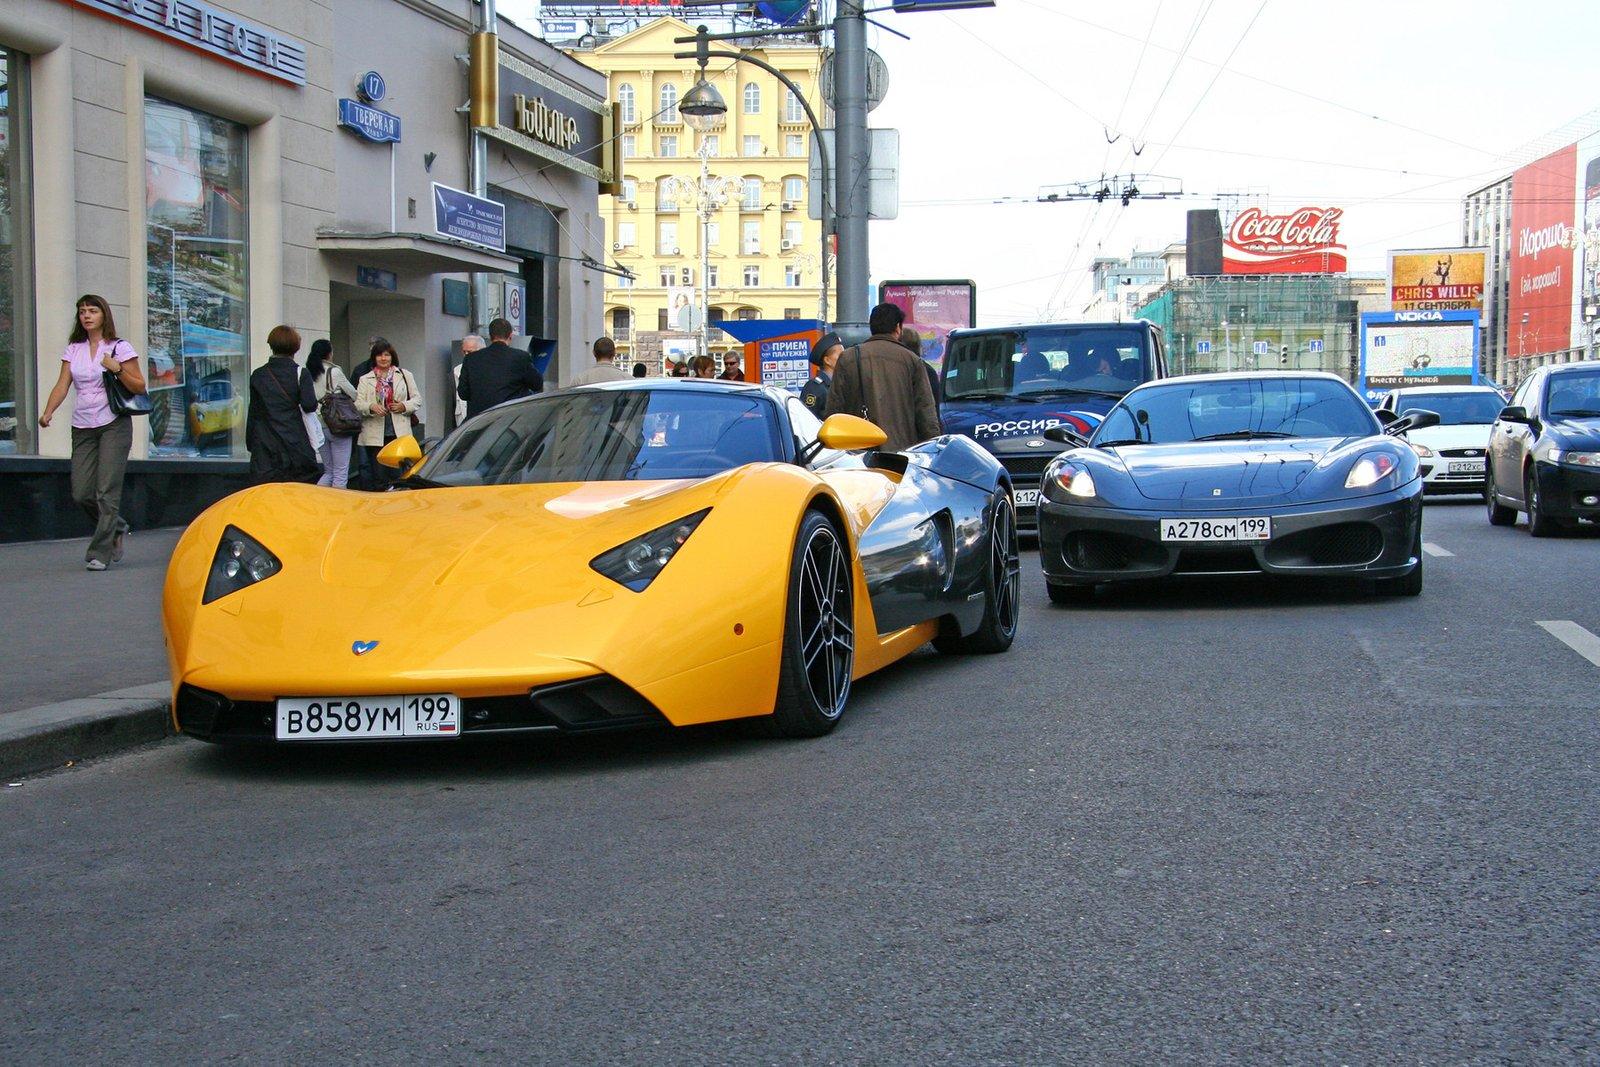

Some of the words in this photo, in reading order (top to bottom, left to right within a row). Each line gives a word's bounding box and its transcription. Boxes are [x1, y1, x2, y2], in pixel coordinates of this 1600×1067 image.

[369, 76, 379, 95] 17
[354, 106, 394, 135] ТВЕРСКАЯ
[1232, 209, 1342, 245] Coca-Cola
[1396, 287, 1433, 300] CHRIS
[1437, 286, 1480, 299] WILLIS
[1404, 302, 1415, 311] 11
[1417, 301, 1471, 311] СЕНТЯБРЯ
[1394, 311, 1443, 321] NOKIA
[772, 341, 808, 351] ПРИЕМ
[772, 349, 808, 358] ПЛАТЕЖЕЙ
[974, 419, 1060, 435] РОССИЯ
[974, 430, 1040, 439] ТЕЛЕКАН
[1240, 519, 1266, 532] 199
[408, 697, 451, 721] 199
[416, 722, 438, 731] RUS
